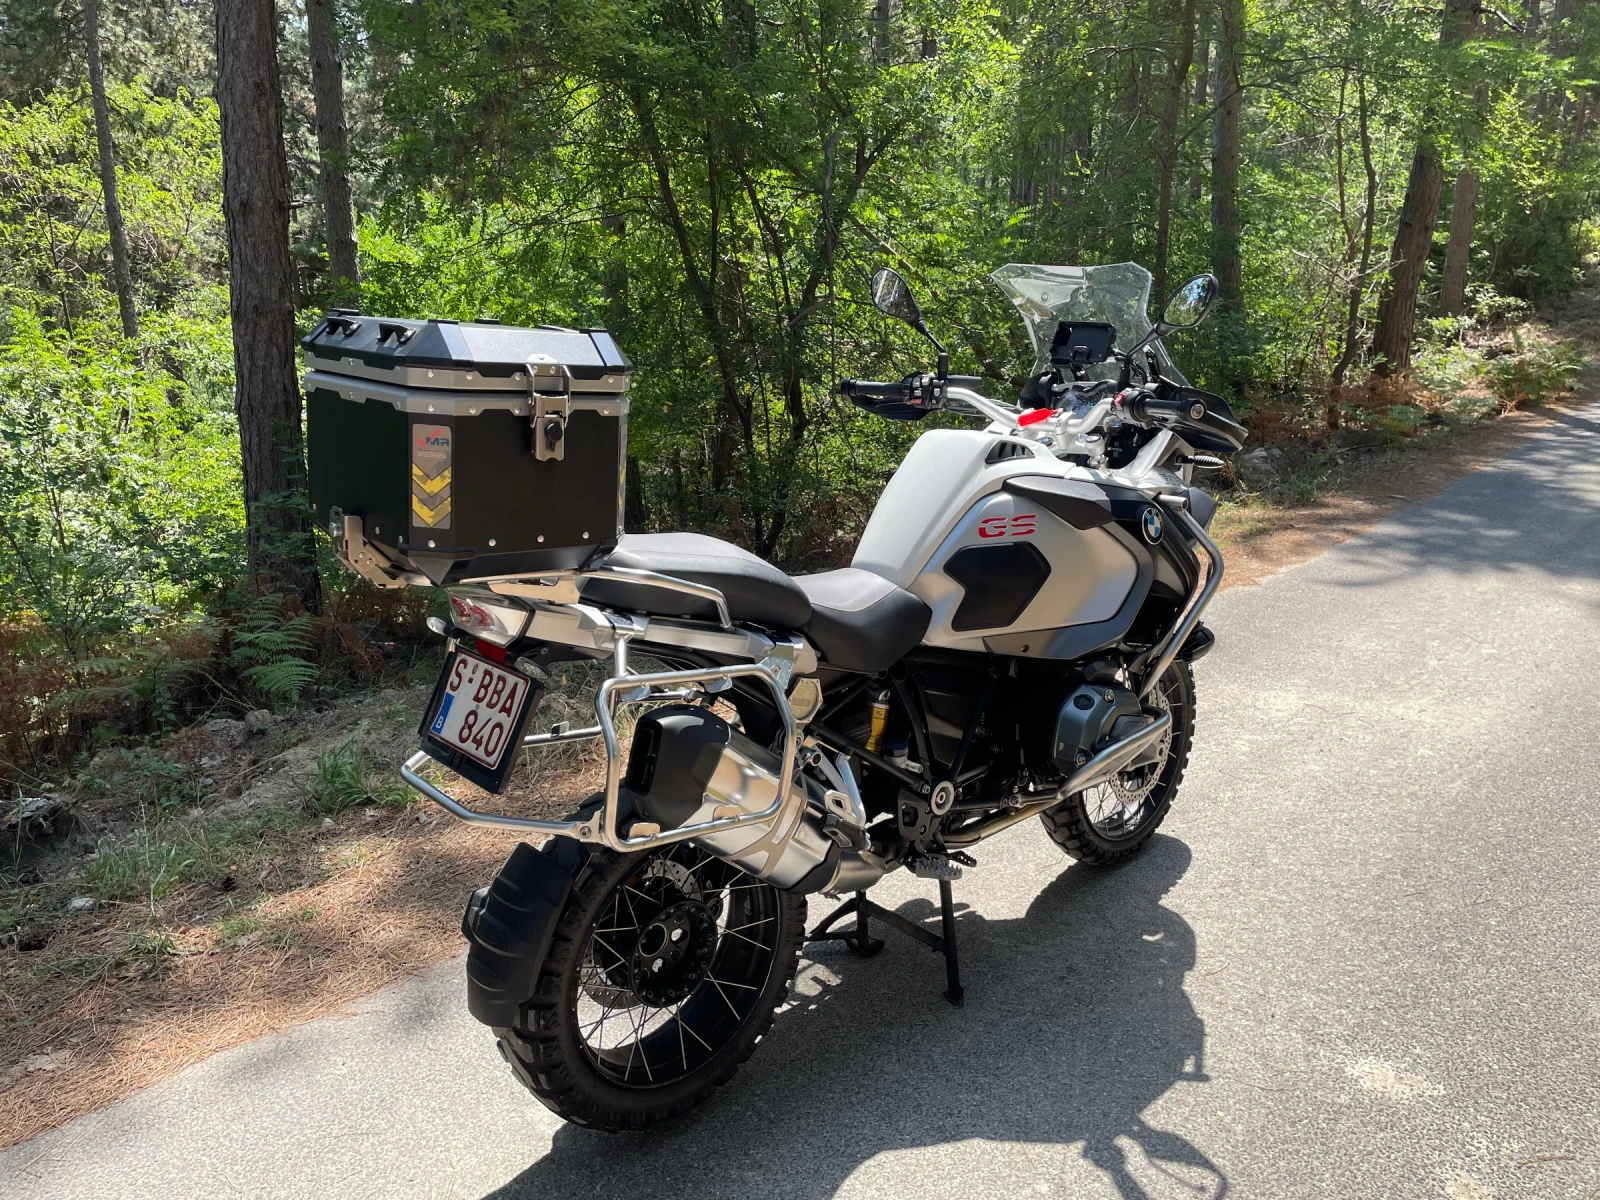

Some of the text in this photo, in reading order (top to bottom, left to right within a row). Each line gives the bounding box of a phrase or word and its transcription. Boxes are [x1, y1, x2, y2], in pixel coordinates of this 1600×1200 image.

[978, 514, 1037, 539] GS
[435, 716, 443, 729] B
[458, 709, 504, 758] 840
